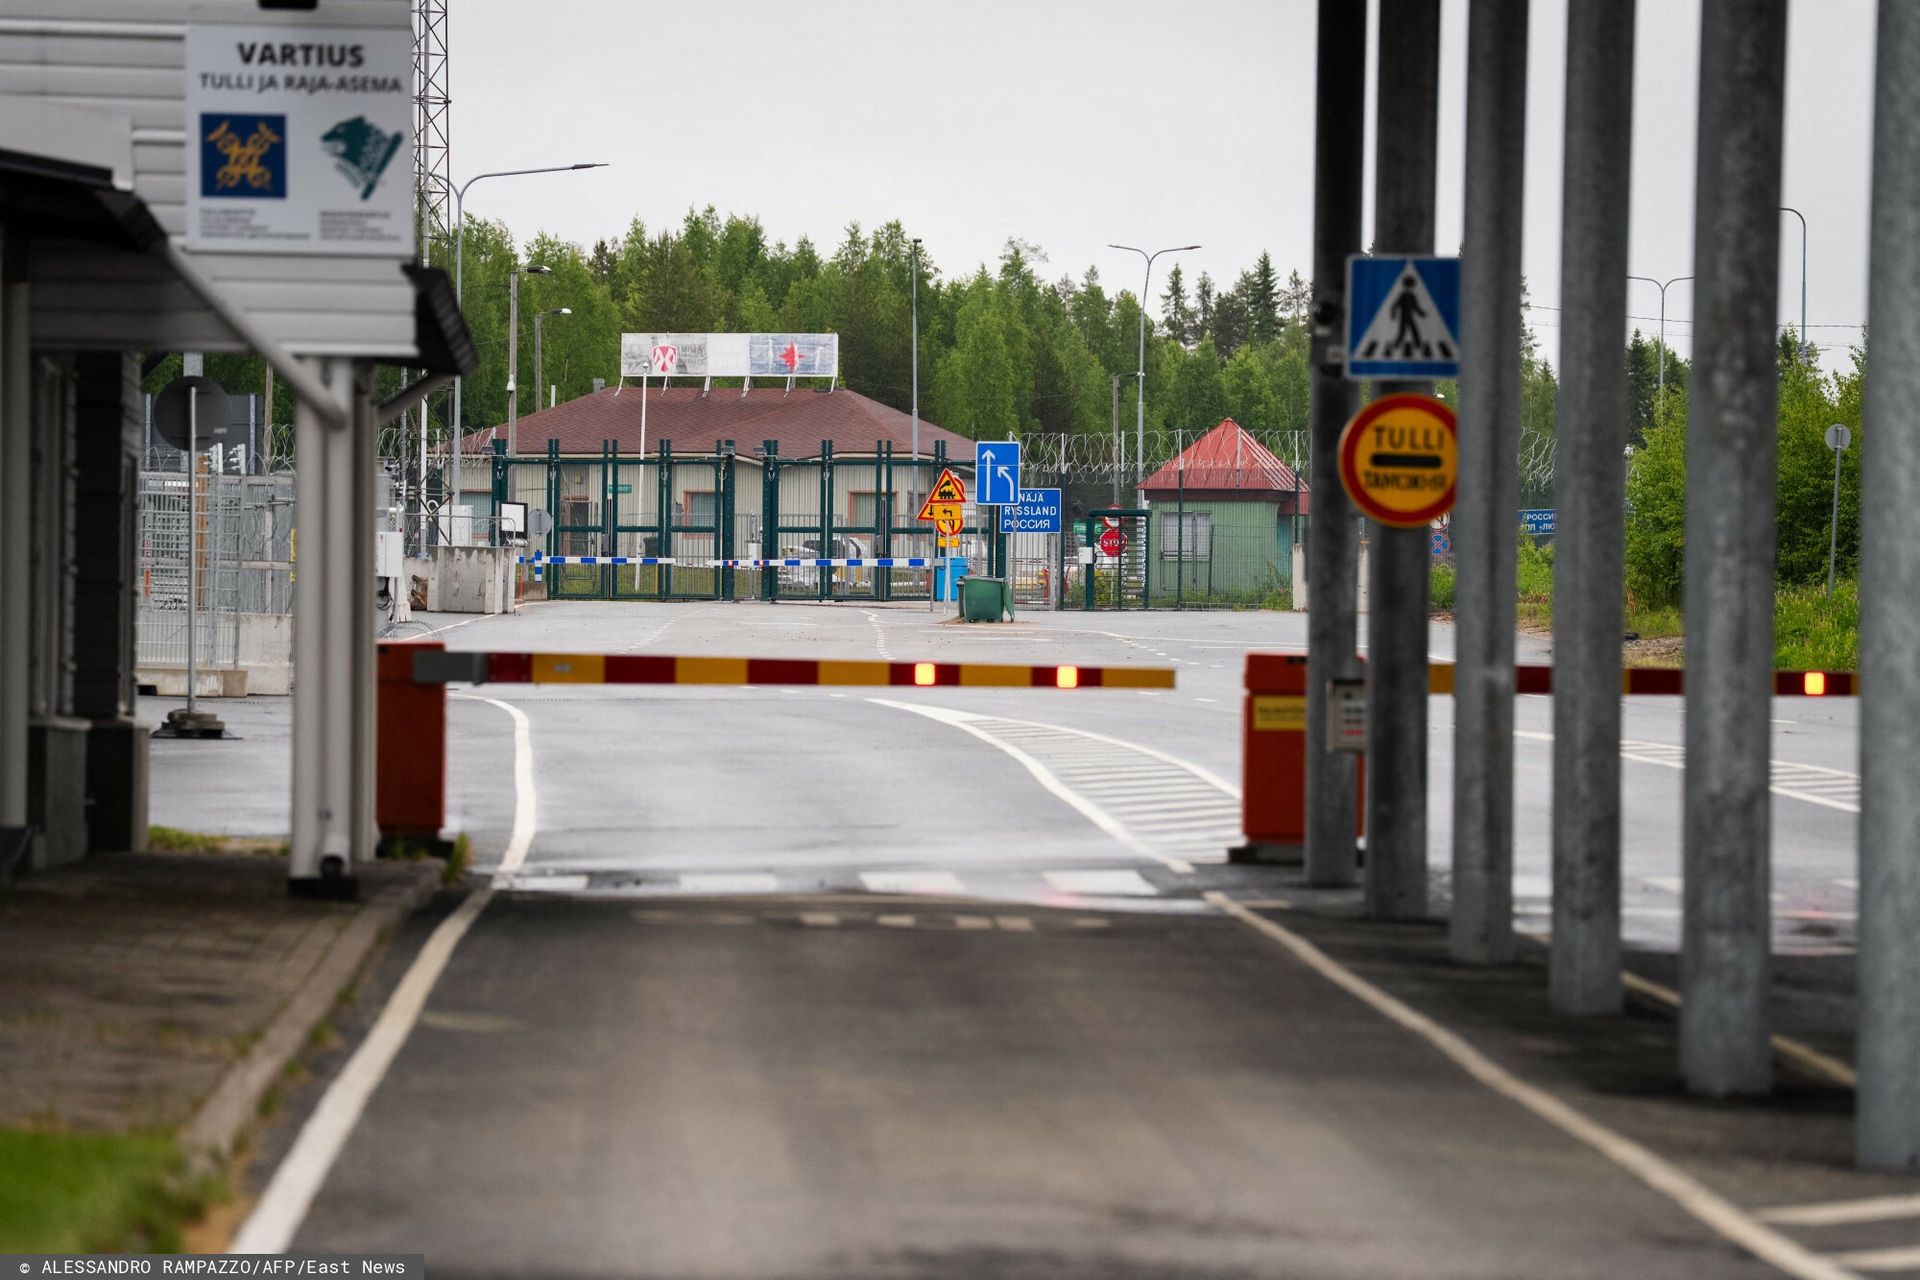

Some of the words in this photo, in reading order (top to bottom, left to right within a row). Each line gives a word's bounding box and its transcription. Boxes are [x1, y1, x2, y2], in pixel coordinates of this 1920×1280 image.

[237, 42, 365, 67] VARTIUS
[200, 72, 253, 90] TULLI
[258, 75, 279, 94] JA
[284, 76, 403, 95] RAJA-ASEMA
[1373, 426, 1445, 450] TULLI
[1019, 491, 1044, 502] NÄJÄ
[1004, 506, 1057, 516] RYSSLAND
[1526, 513, 1556, 521] РОССИ
[1004, 519, 1050, 529] РОССИЯ
